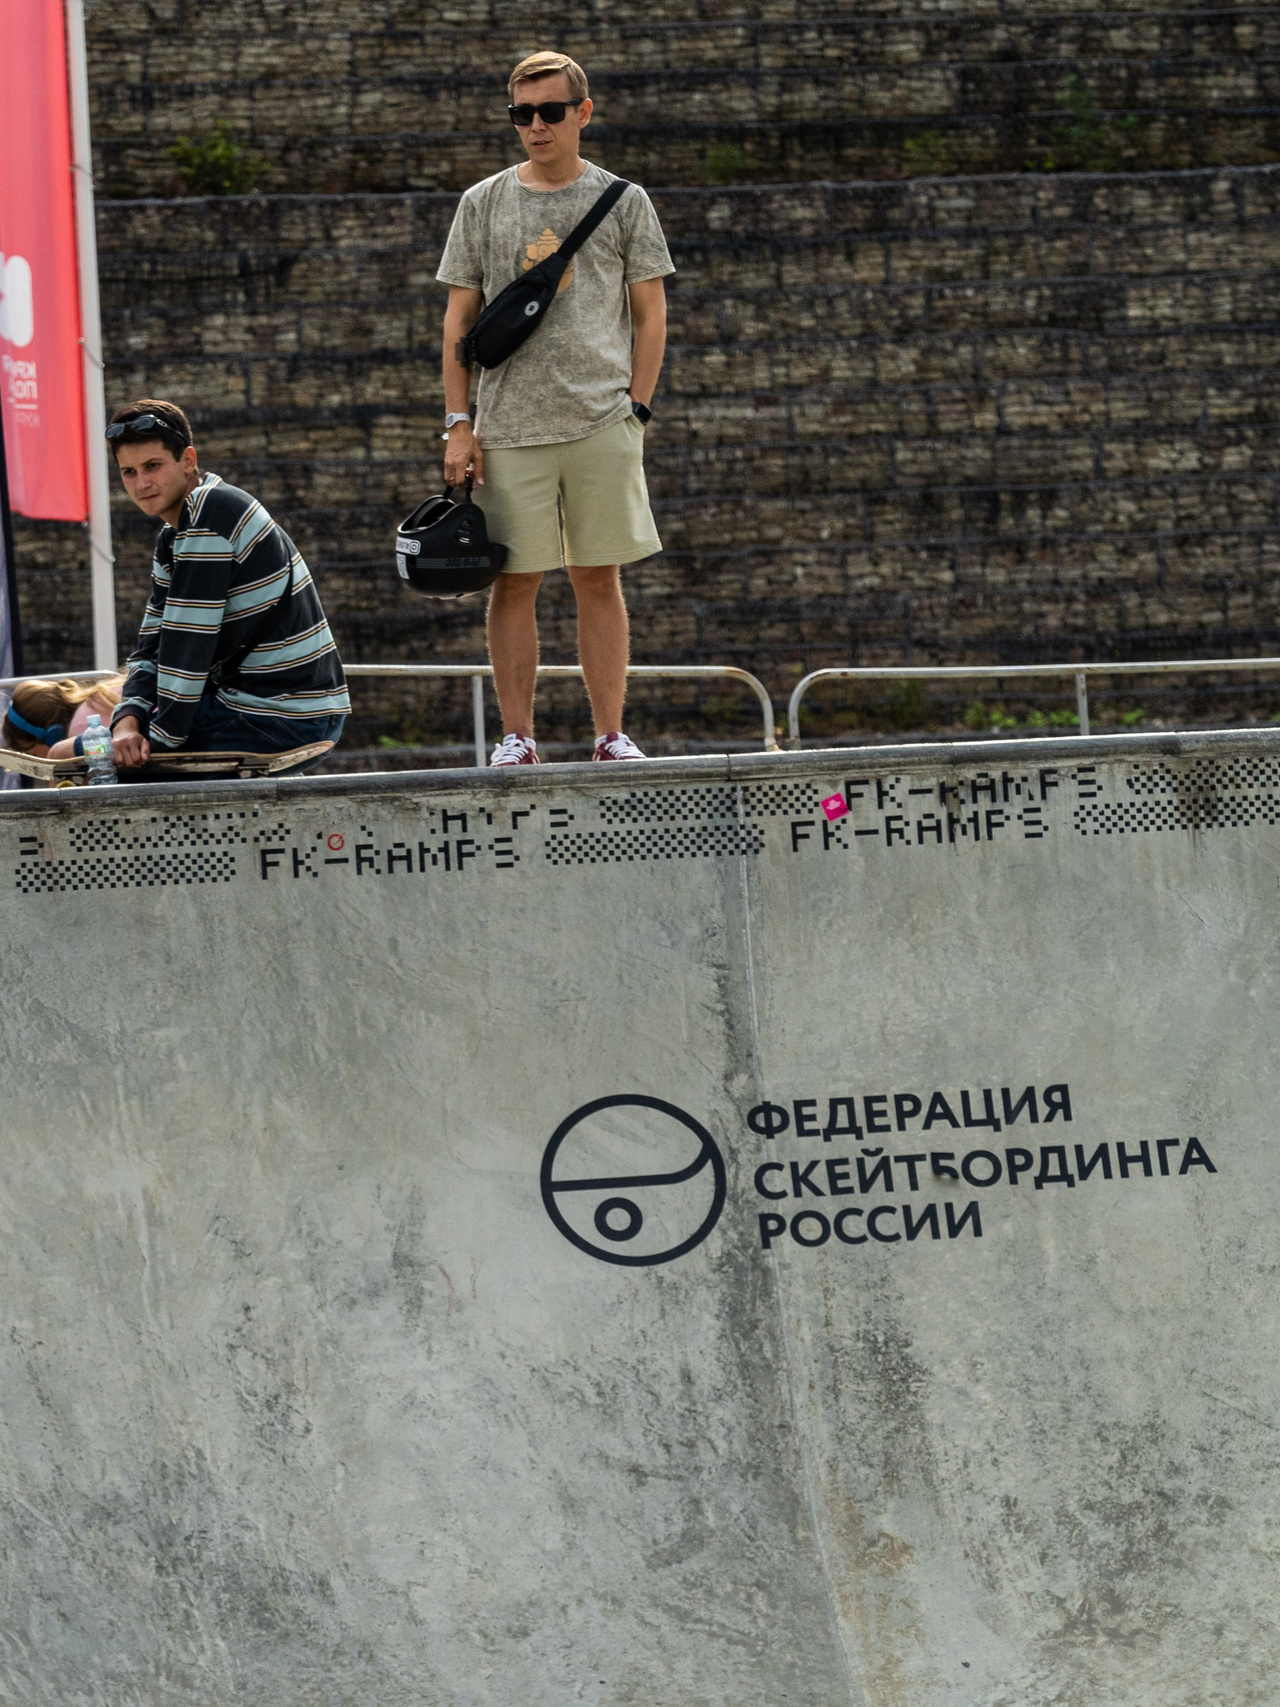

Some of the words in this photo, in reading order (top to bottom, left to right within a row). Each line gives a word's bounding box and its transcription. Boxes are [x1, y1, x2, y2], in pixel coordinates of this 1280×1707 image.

[260, 837, 521, 880] FK-RAMPS
[747, 1084, 1073, 1142] ФЕДЕРАЦИЯ
[753, 1137, 1219, 1200] СКЕЙТБОРДИНГА
[758, 1201, 984, 1249] РОССИИ
